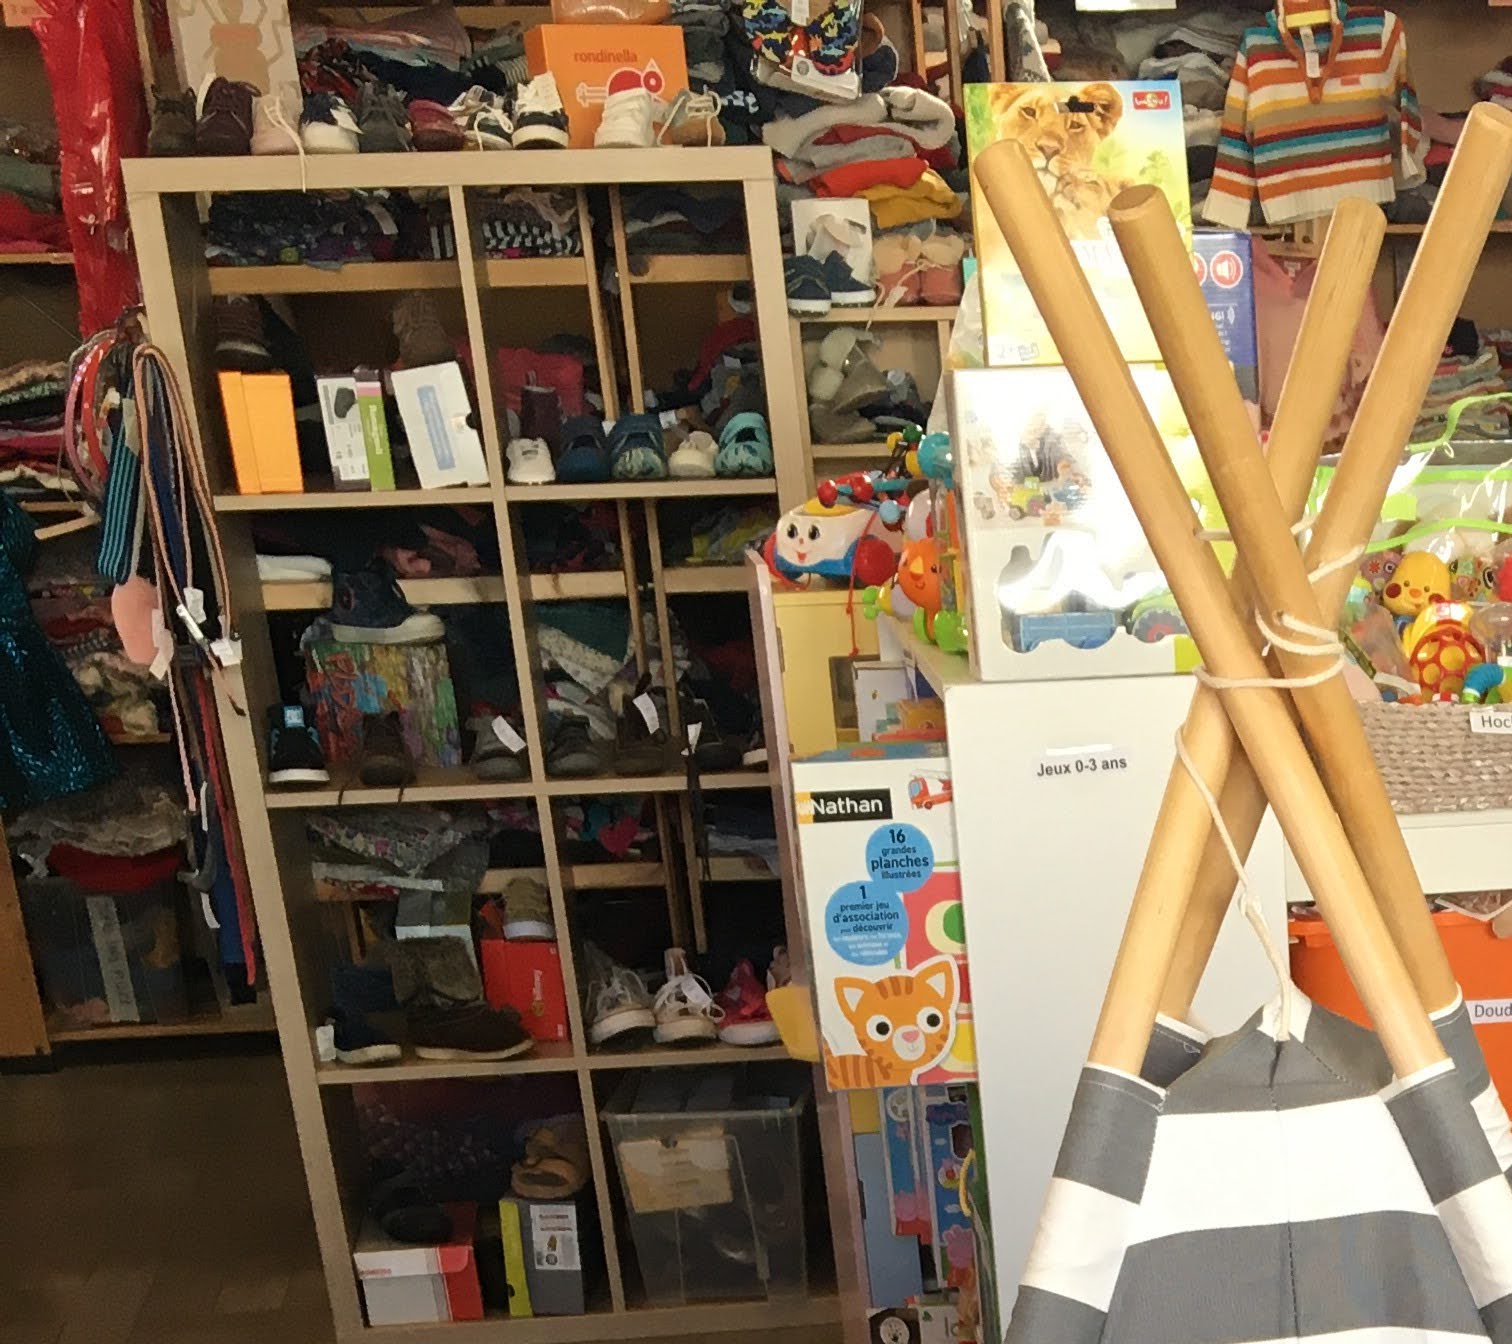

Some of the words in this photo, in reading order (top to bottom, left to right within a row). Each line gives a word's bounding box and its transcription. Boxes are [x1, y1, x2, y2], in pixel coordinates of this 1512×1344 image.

[573, 48, 638, 63] rondinella
[1037, 762, 1072, 777] Jeux
[1074, 758, 1098, 773] 0-3
[1101, 757, 1128, 770] ans
[810, 796, 884, 816] Nathan
[888, 828, 906, 844] 16
[881, 845, 917, 857] grandes
[871, 855, 930, 873] planches
[859, 885, 867, 899] 1
[840, 901, 874, 912] premier
[875, 900, 890, 911] jeu
[832, 910, 900, 924] d'association
[852, 922, 894, 933] découvrir
